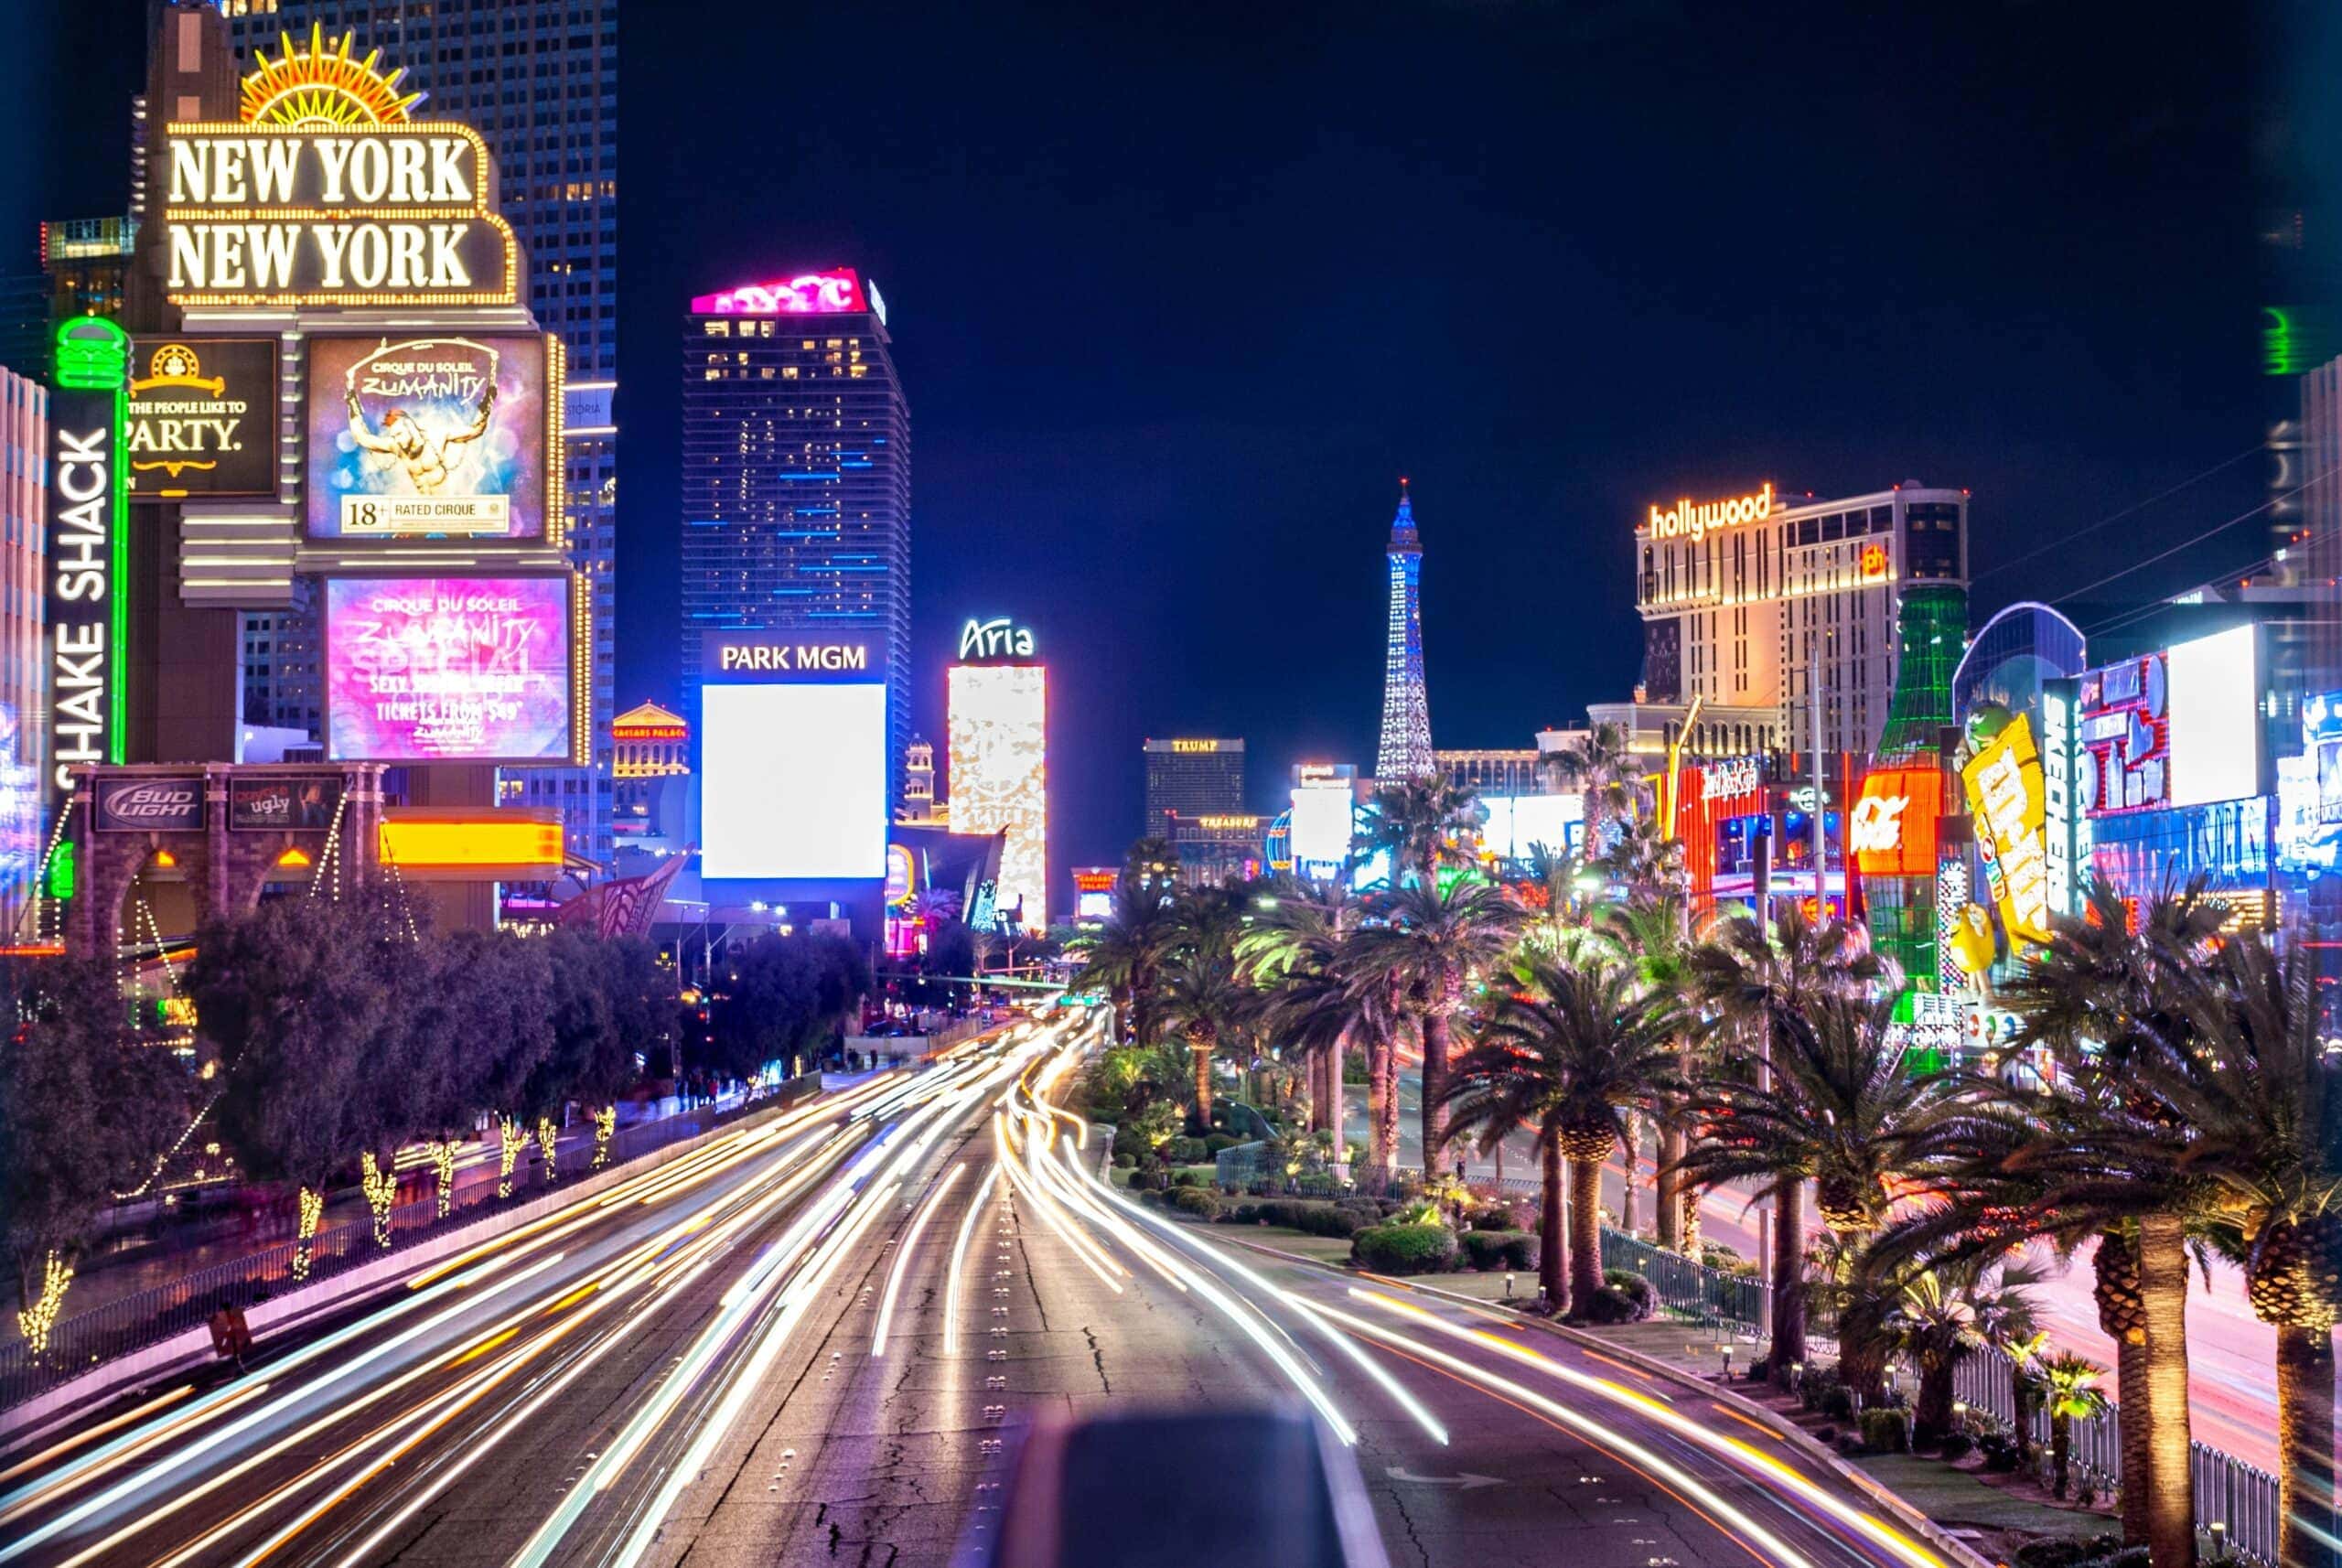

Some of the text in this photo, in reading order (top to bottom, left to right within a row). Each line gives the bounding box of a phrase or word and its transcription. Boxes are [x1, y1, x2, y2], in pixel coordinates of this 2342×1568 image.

[168, 137, 473, 203] NEW YORK
[167, 223, 472, 288] NEW YORK
[371, 361, 477, 375] CIRQUE DU SOLEIL
[360, 372, 486, 405] ZUMANITY
[128, 401, 247, 413] THE PEOPLE LIKE TO
[57, 426, 107, 602] SHACK
[395, 503, 432, 517] RATED
[434, 503, 477, 517] CIRQUE
[1649, 481, 1772, 542] hollywood
[371, 597, 523, 616] CIRQUE DU SOLEIL
[959, 618, 1035, 660] Aria
[721, 646, 865, 670] PARK MGM
[376, 701, 436, 721] TICKETS
[1172, 739, 1219, 753] TRUMP
[130, 789, 194, 804] BUD
[250, 794, 291, 815] ugly
[2042, 691, 2069, 916] SKECHERS
[116, 803, 199, 817] LIGHT
[1198, 816, 1259, 829] TREASURE
